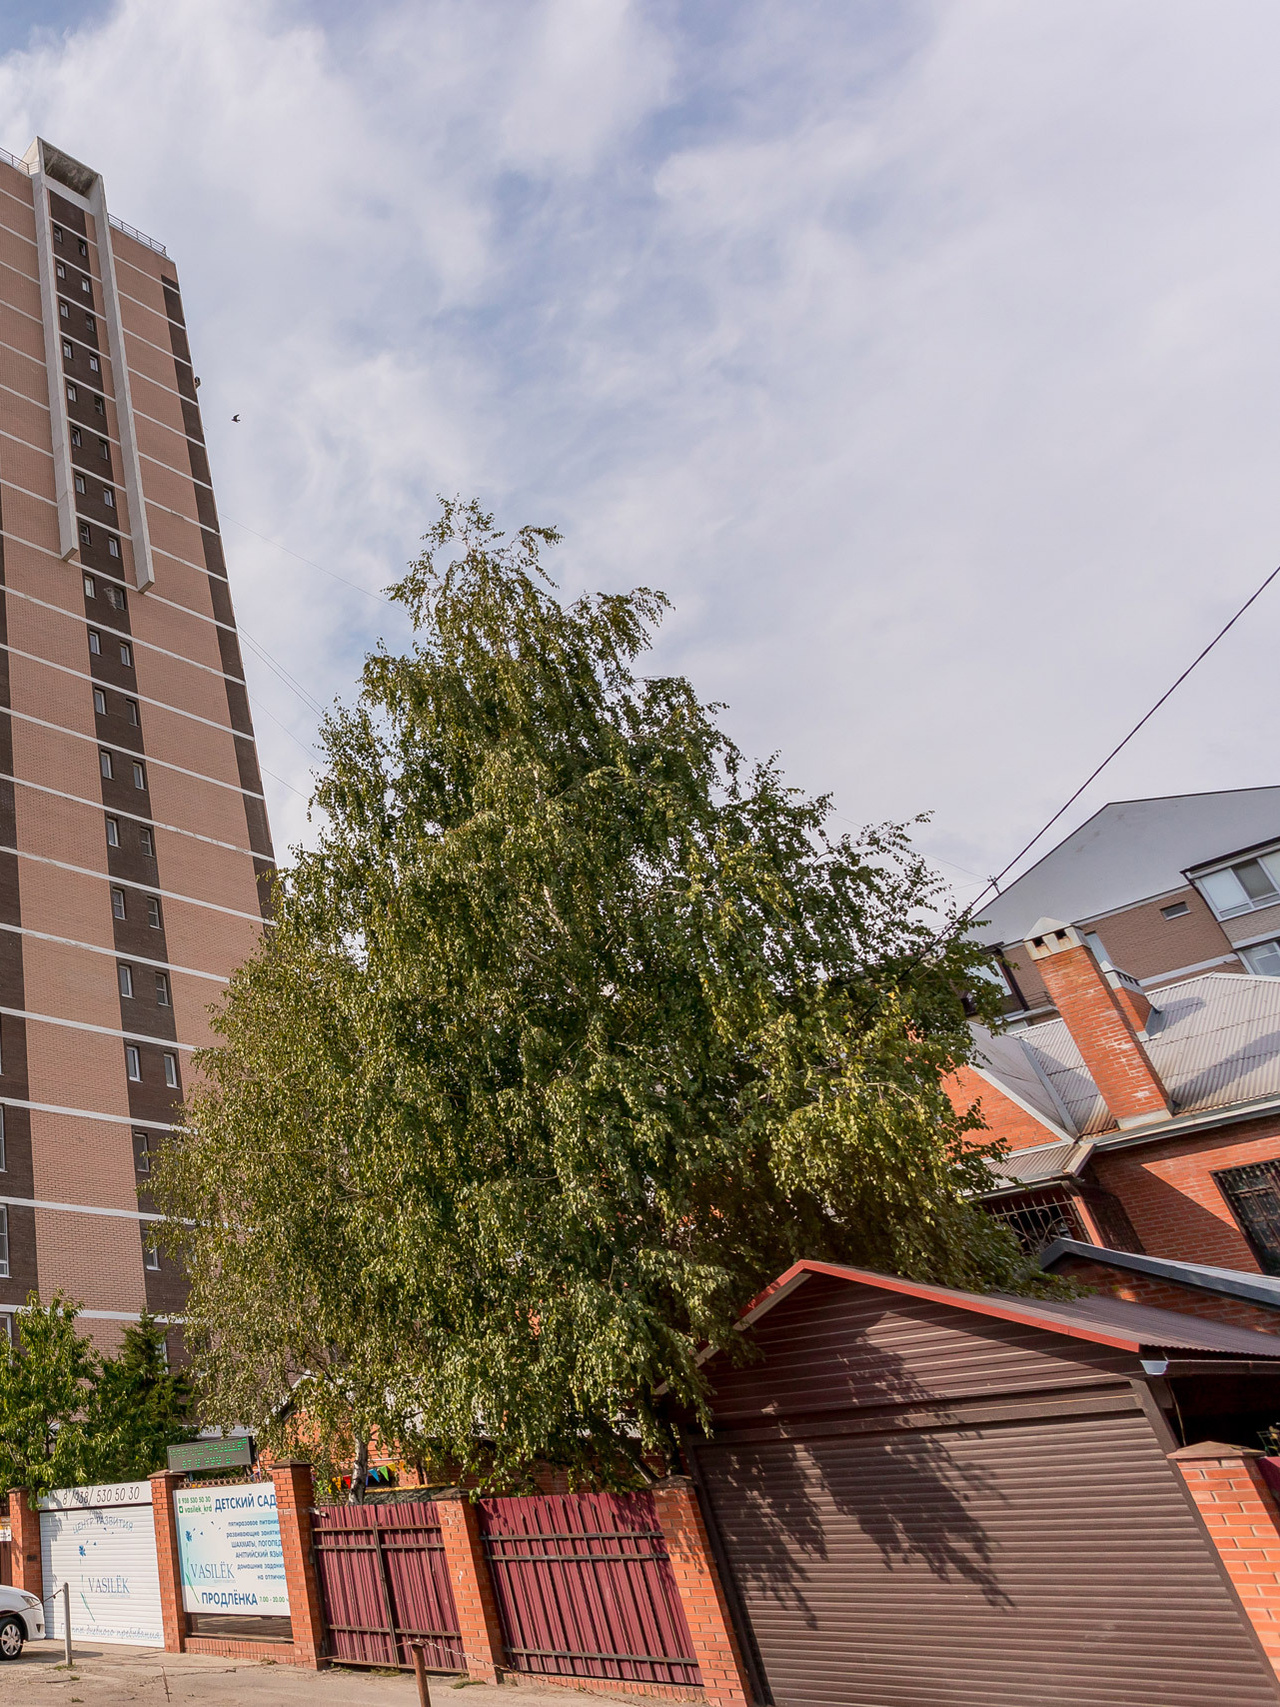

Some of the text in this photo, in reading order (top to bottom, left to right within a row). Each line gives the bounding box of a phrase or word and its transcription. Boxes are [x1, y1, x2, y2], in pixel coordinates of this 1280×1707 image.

[62, 1493, 68, 1506] 8
[96, 1489, 113, 1503] 530
[115, 1487, 126, 1501] 50
[128, 1486, 140, 1500] 30
[214, 1492, 277, 1513] ДЕТСКИЙ САД
[73, 1515, 134, 1534] ЦЕНТР РАЗВИТИЯ
[190, 1561, 235, 1579] VASILËK
[88, 1574, 130, 1594] VASILËK
[201, 1589, 258, 1608] ПРОДЛЁНКА
